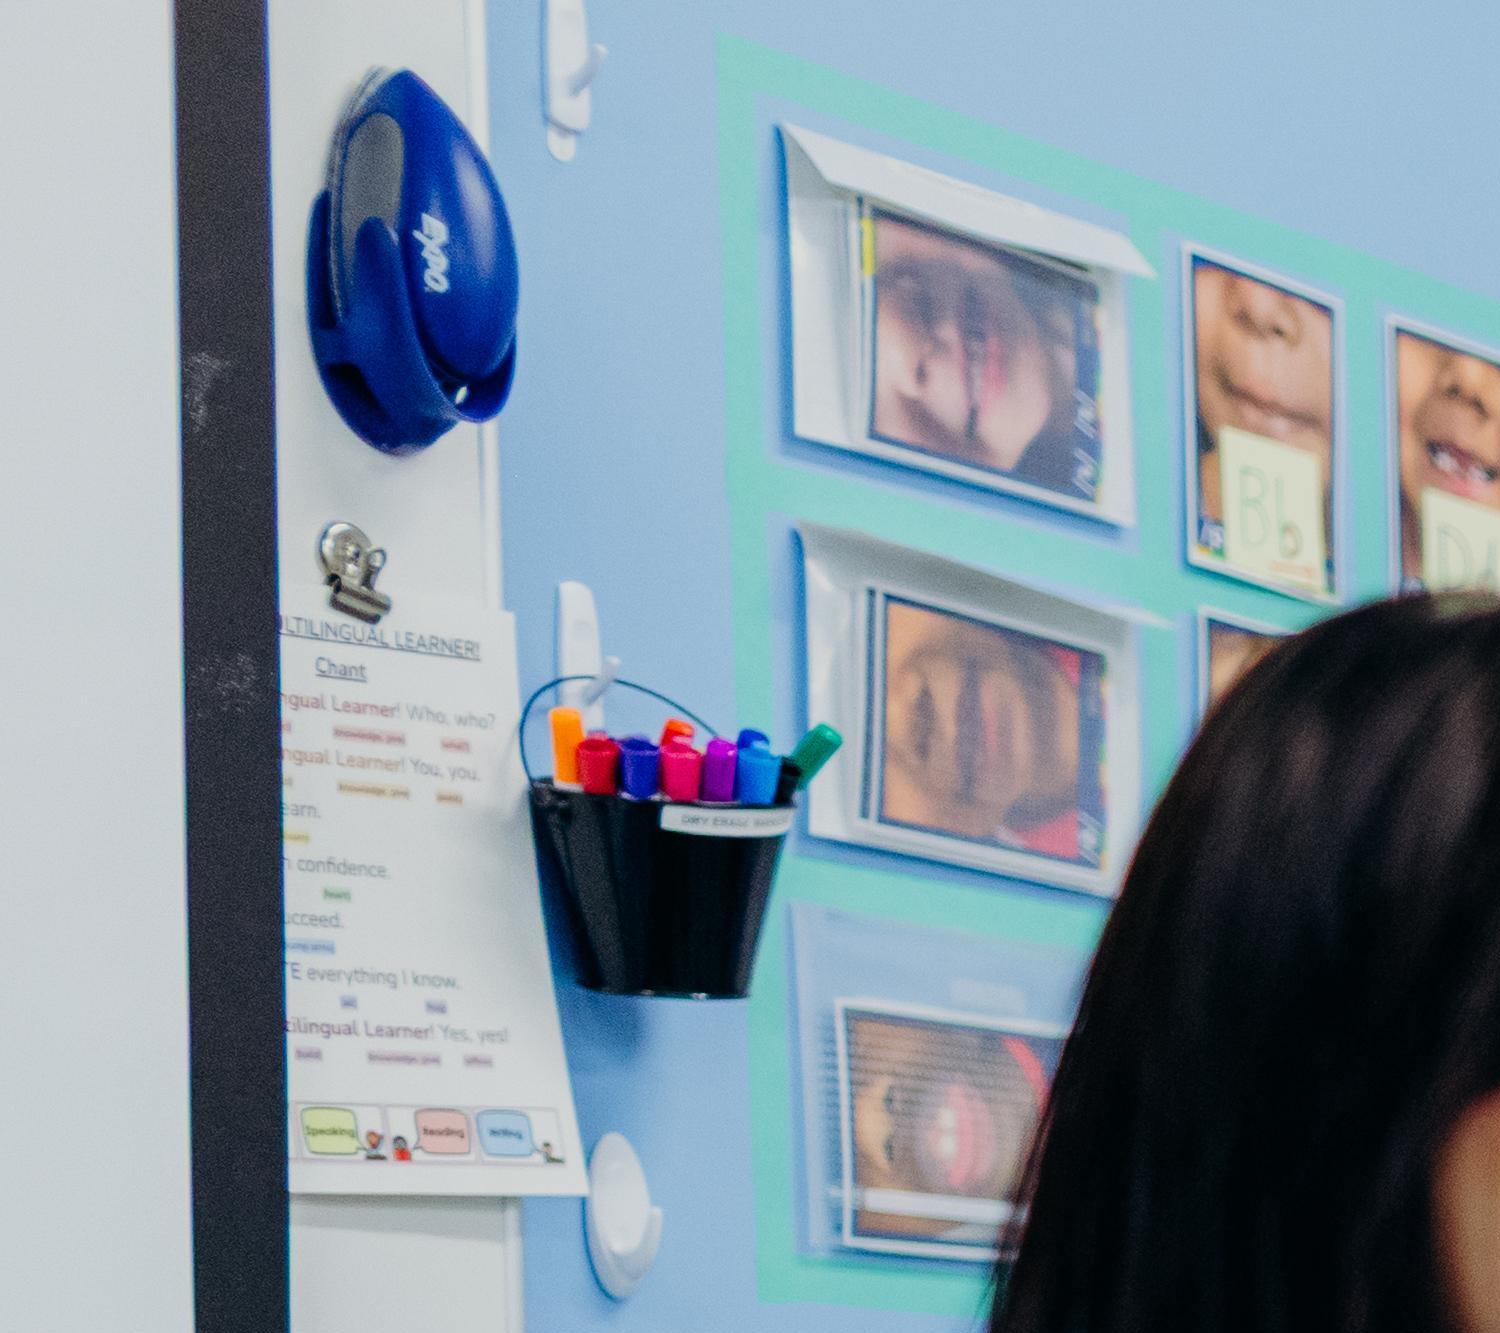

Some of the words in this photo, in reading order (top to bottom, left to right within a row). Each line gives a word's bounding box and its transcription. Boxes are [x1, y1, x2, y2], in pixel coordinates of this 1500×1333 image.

[280, 615, 389, 649] LTILINGUAL
[395, 631, 480, 657] LEARNER!
[315, 656, 367, 679] Chant
[331, 694, 400, 717] Learner!
[406, 702, 449, 726] Who,
[454, 712, 496, 729] who?
[335, 750, 405, 773] Learner!
[408, 757, 444, 777] You,
[447, 766, 482, 781] you.
[297, 857, 392, 878] confidence.
[306, 967, 398, 989] everything
[411, 971, 461, 989] know.
[364, 1020, 434, 1041] Learner!
[438, 1024, 473, 1043] Yes,
[477, 1026, 509, 1047] yes!
